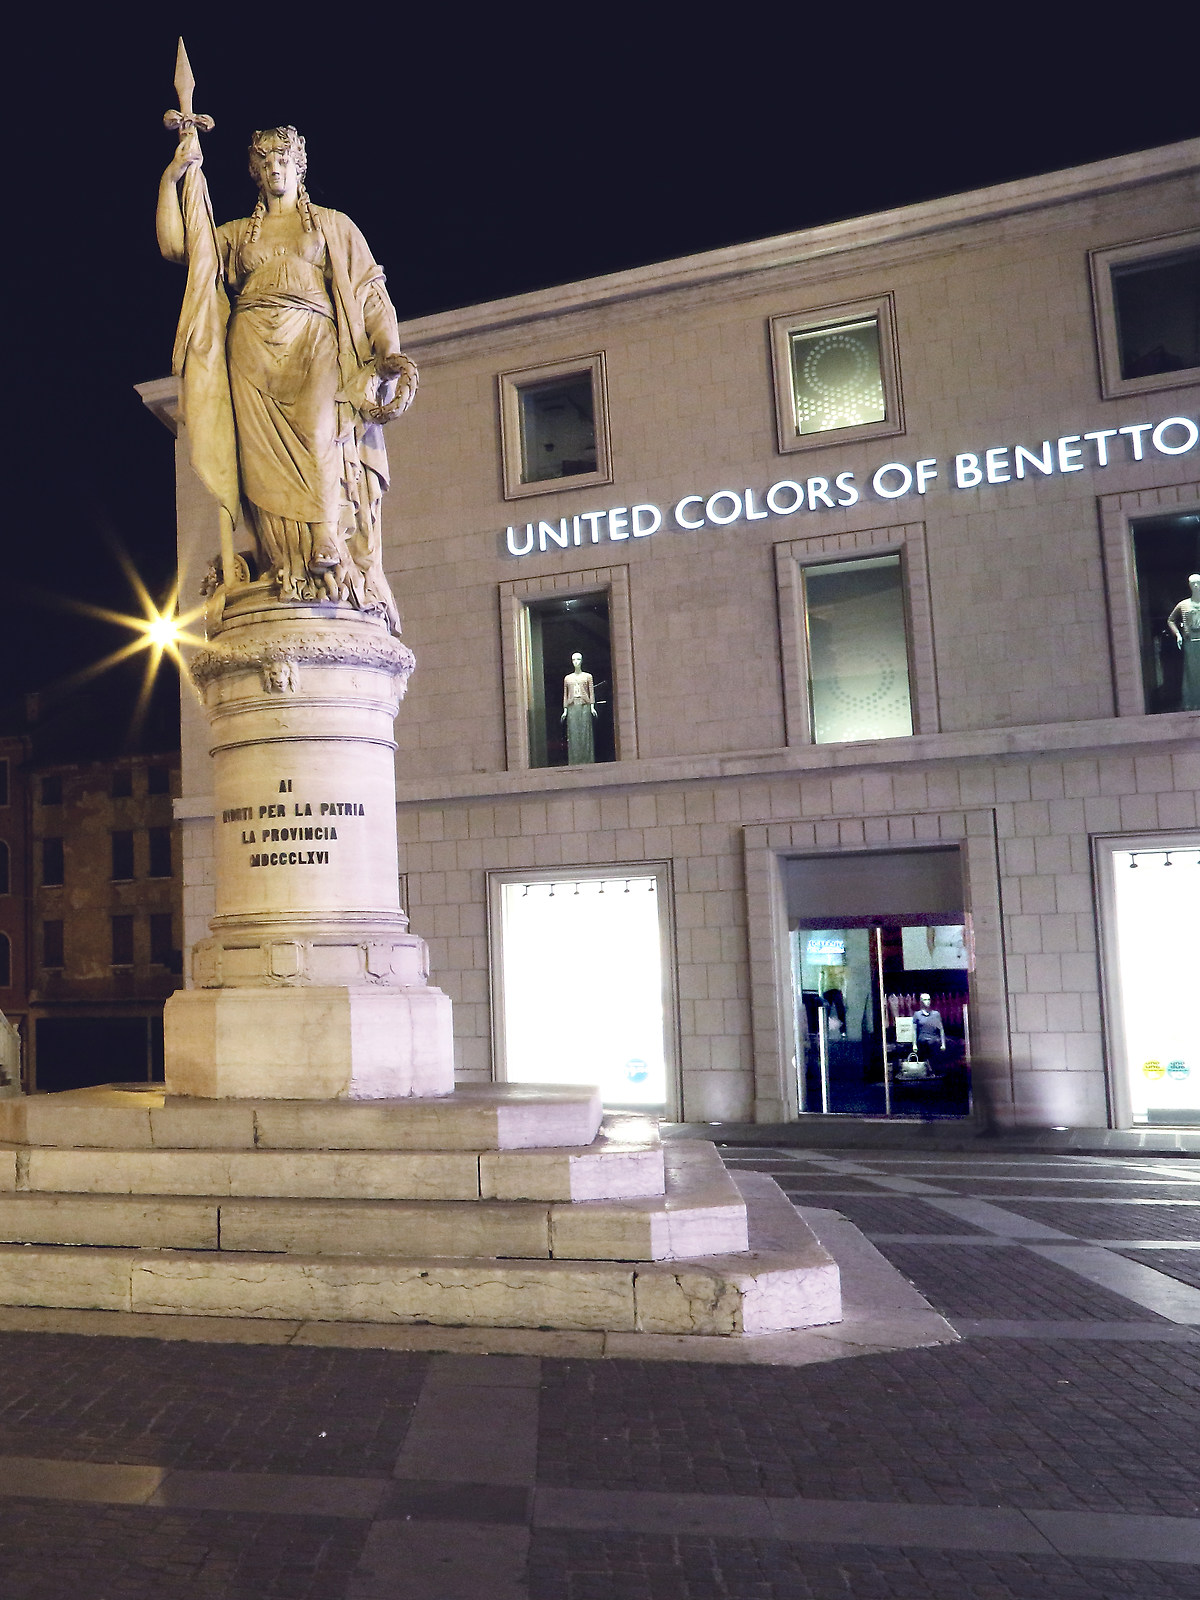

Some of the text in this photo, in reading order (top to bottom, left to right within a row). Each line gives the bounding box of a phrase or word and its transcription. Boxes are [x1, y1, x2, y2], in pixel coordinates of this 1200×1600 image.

[506, 416, 1199, 556] UNITED COLORS OF BENETTO
[278, 779, 293, 793] AI
[259, 804, 286, 818] PER
[295, 803, 313, 817] LA
[320, 802, 366, 817] PATRIA
[242, 827, 338, 844] LA PROVINCIA
[250, 851, 329, 868] MDCCCLXVI
